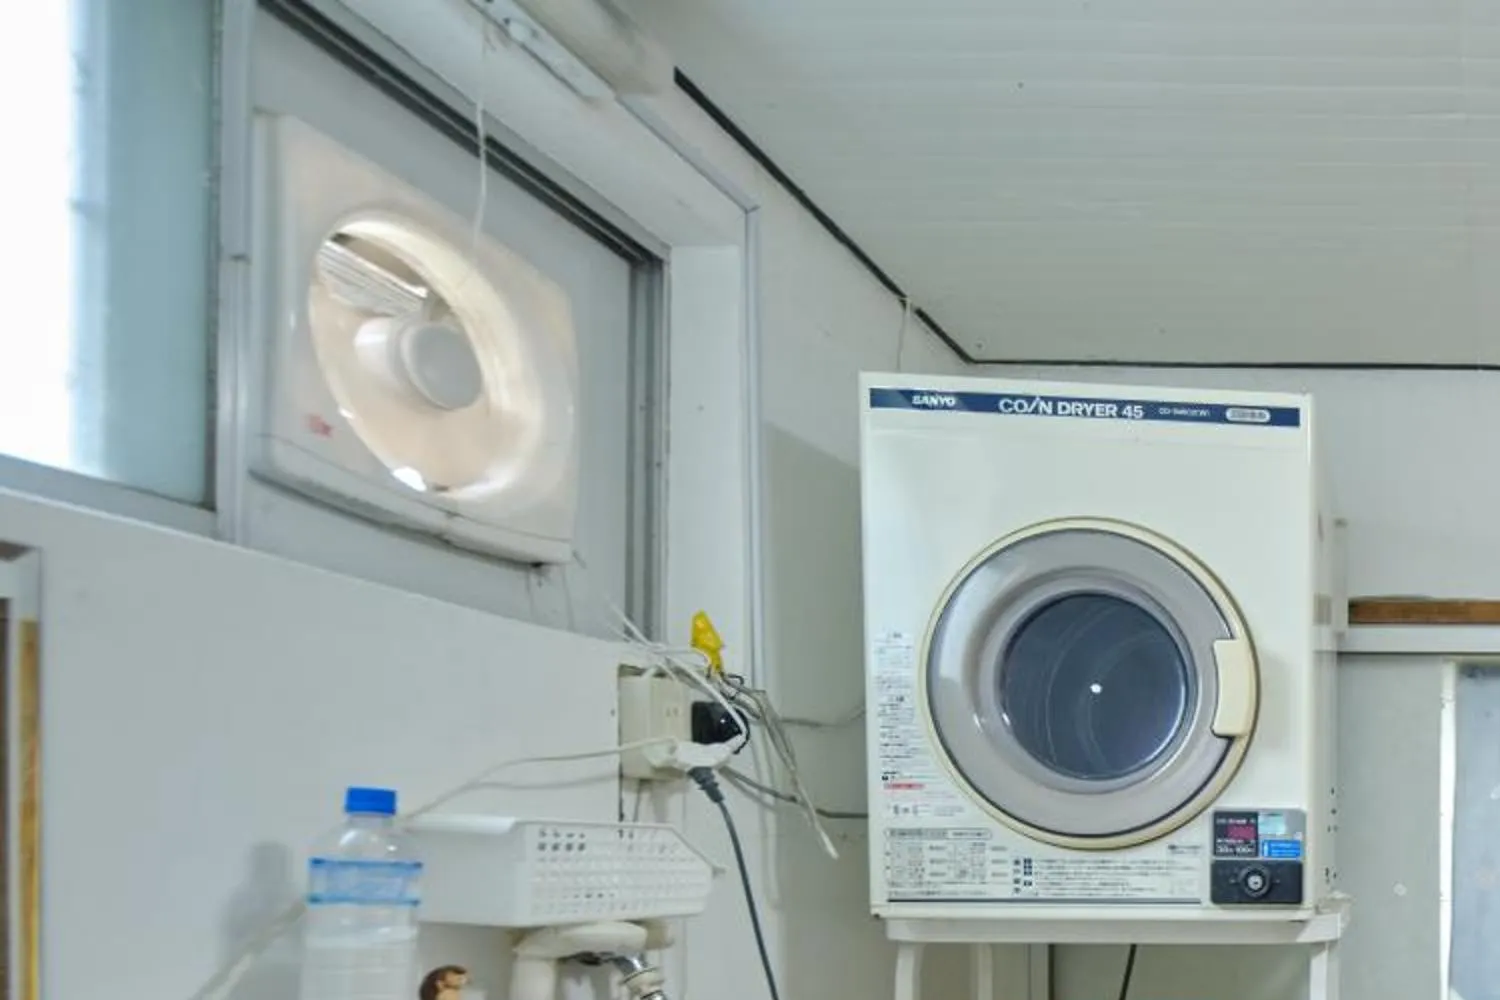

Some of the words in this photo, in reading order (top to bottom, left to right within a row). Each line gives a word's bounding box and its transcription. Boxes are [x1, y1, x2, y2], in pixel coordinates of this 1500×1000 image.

[911, 395, 957, 409] SANYO
[1057, 401, 1118, 417] DRYER
[1121, 405, 1145, 419] 45
